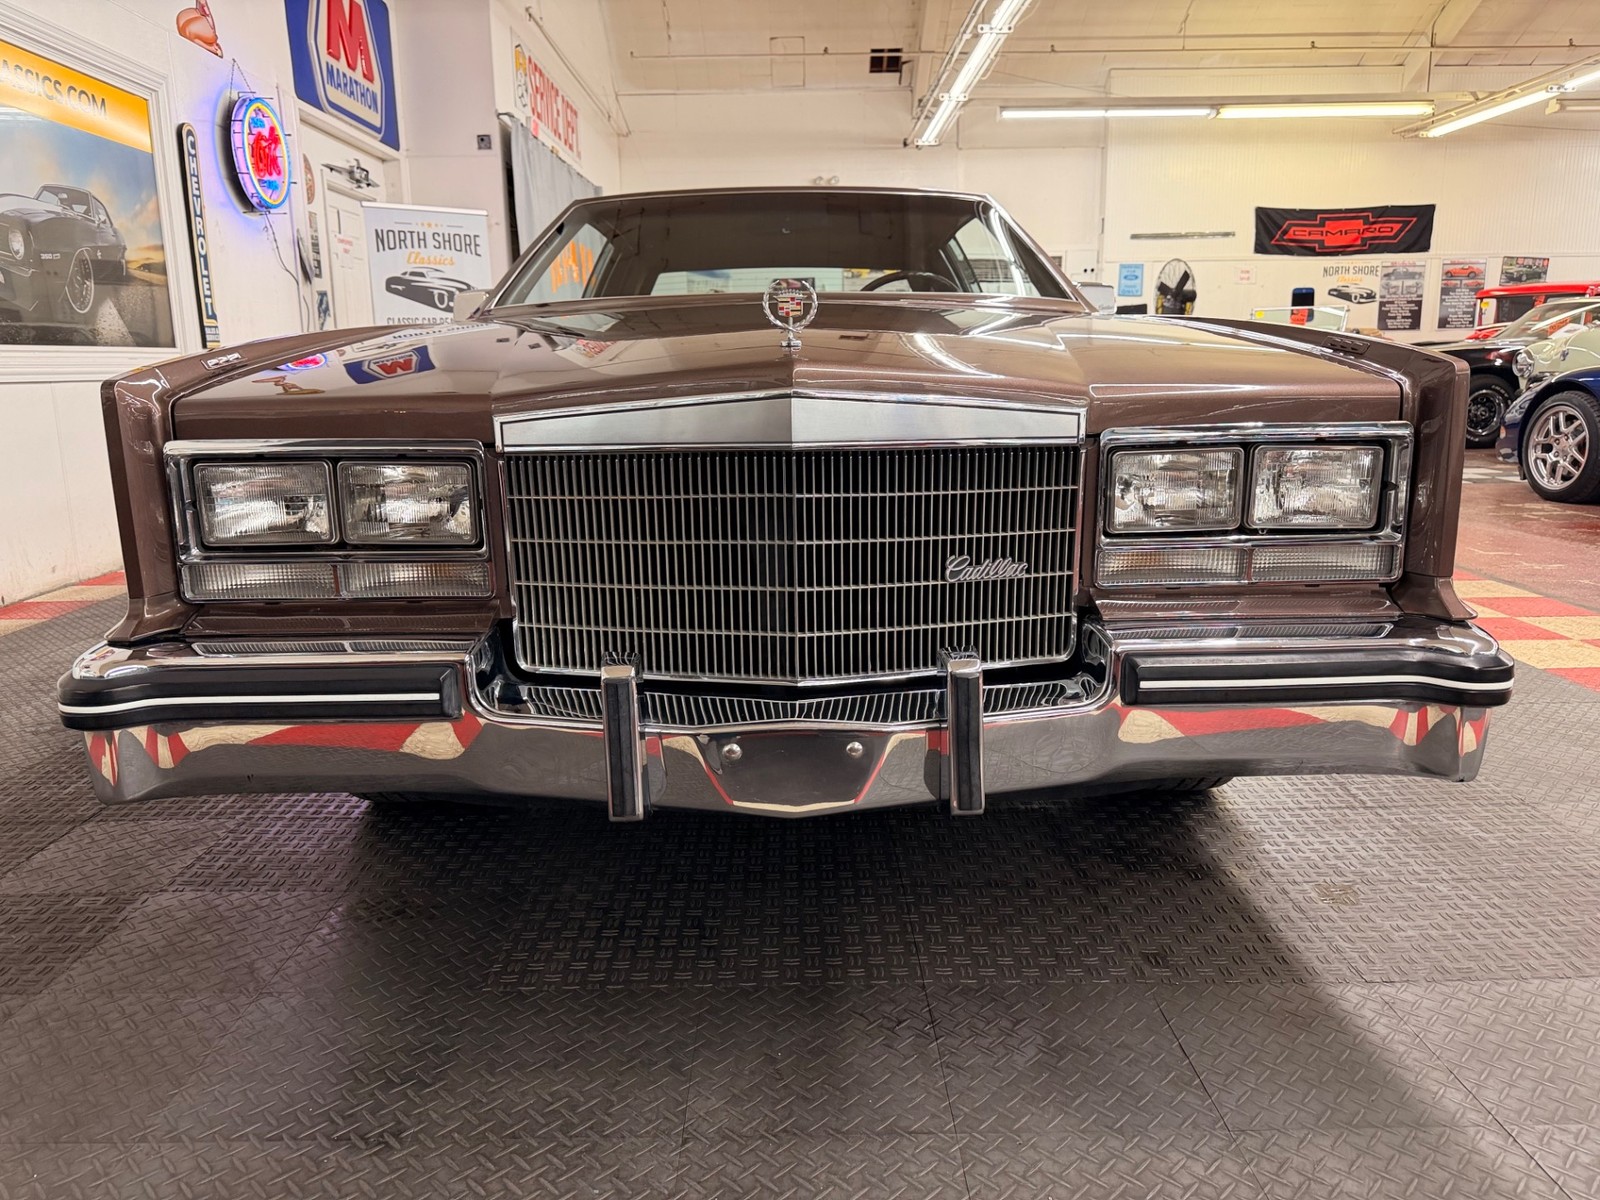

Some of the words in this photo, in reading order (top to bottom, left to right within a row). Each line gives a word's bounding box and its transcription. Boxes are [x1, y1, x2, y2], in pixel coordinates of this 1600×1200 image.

[325, 61, 379, 114] MARATHON
[527, 55, 561, 141] SERVICE
[186, 134, 213, 316] CHEVROLET
[1292, 225, 1394, 237] CAMARO
[374, 228, 428, 253] NORTH
[432, 231, 482, 257] SHORE
[406, 250, 455, 266] Classics
[1323, 265, 1350, 278] NORTH
[1352, 265, 1380, 277] SHORE
[945, 555, 1028, 582] Cadillac
